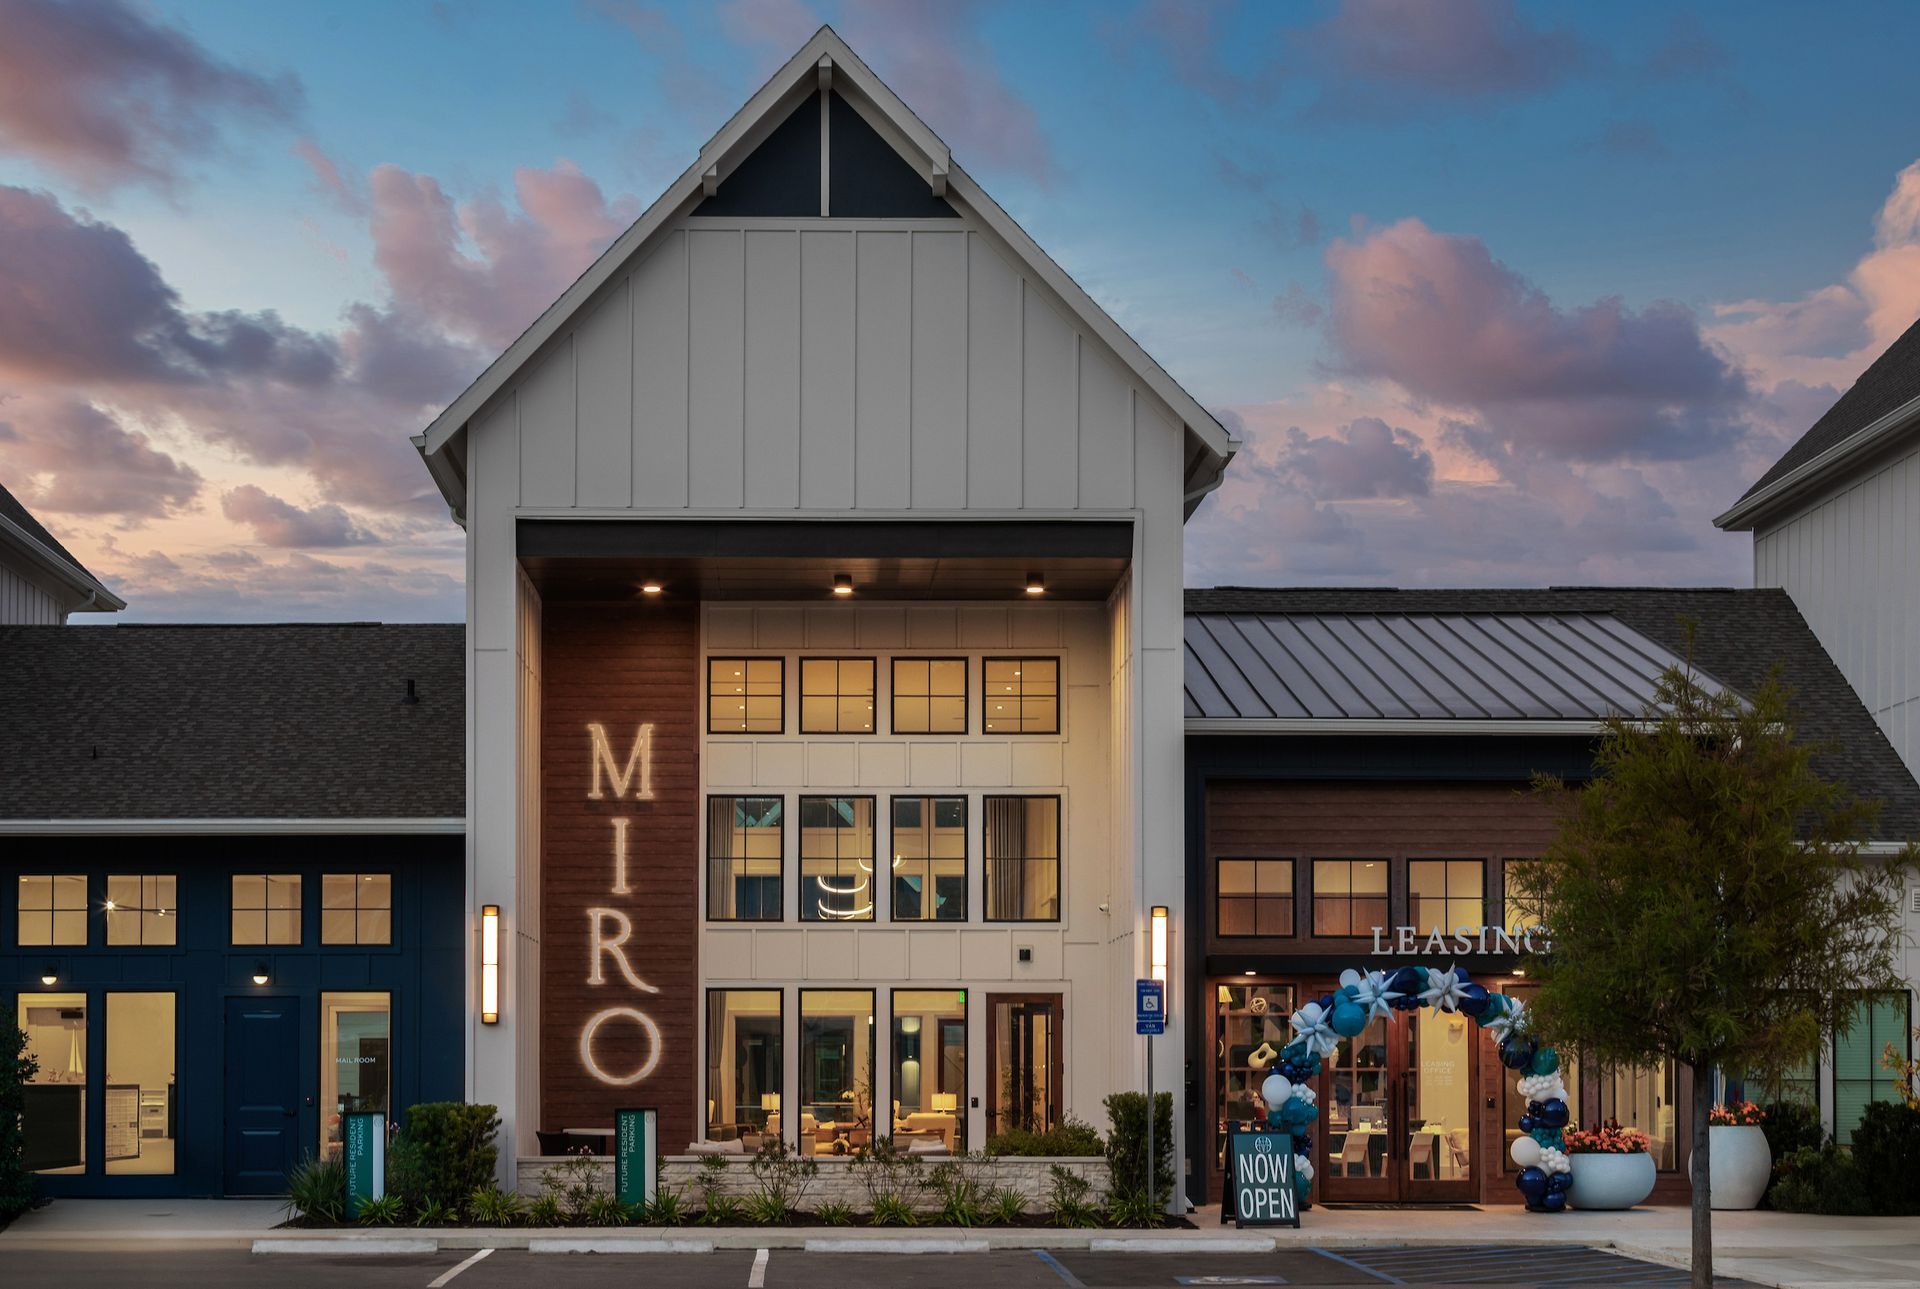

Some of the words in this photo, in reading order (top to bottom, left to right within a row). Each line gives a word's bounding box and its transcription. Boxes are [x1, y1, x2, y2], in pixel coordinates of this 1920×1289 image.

[579, 722, 662, 1086] MIRO
[335, 1056, 353, 1064] MAIL
[353, 1056, 376, 1064] ROOM
[349, 1117, 357, 1161] RESIDENT
[628, 1114, 636, 1153] PARKING
[349, 1161, 357, 1196] FUTURE
[1239, 1153, 1288, 1184] NOW
[1240, 1187, 1295, 1219] OPEN
